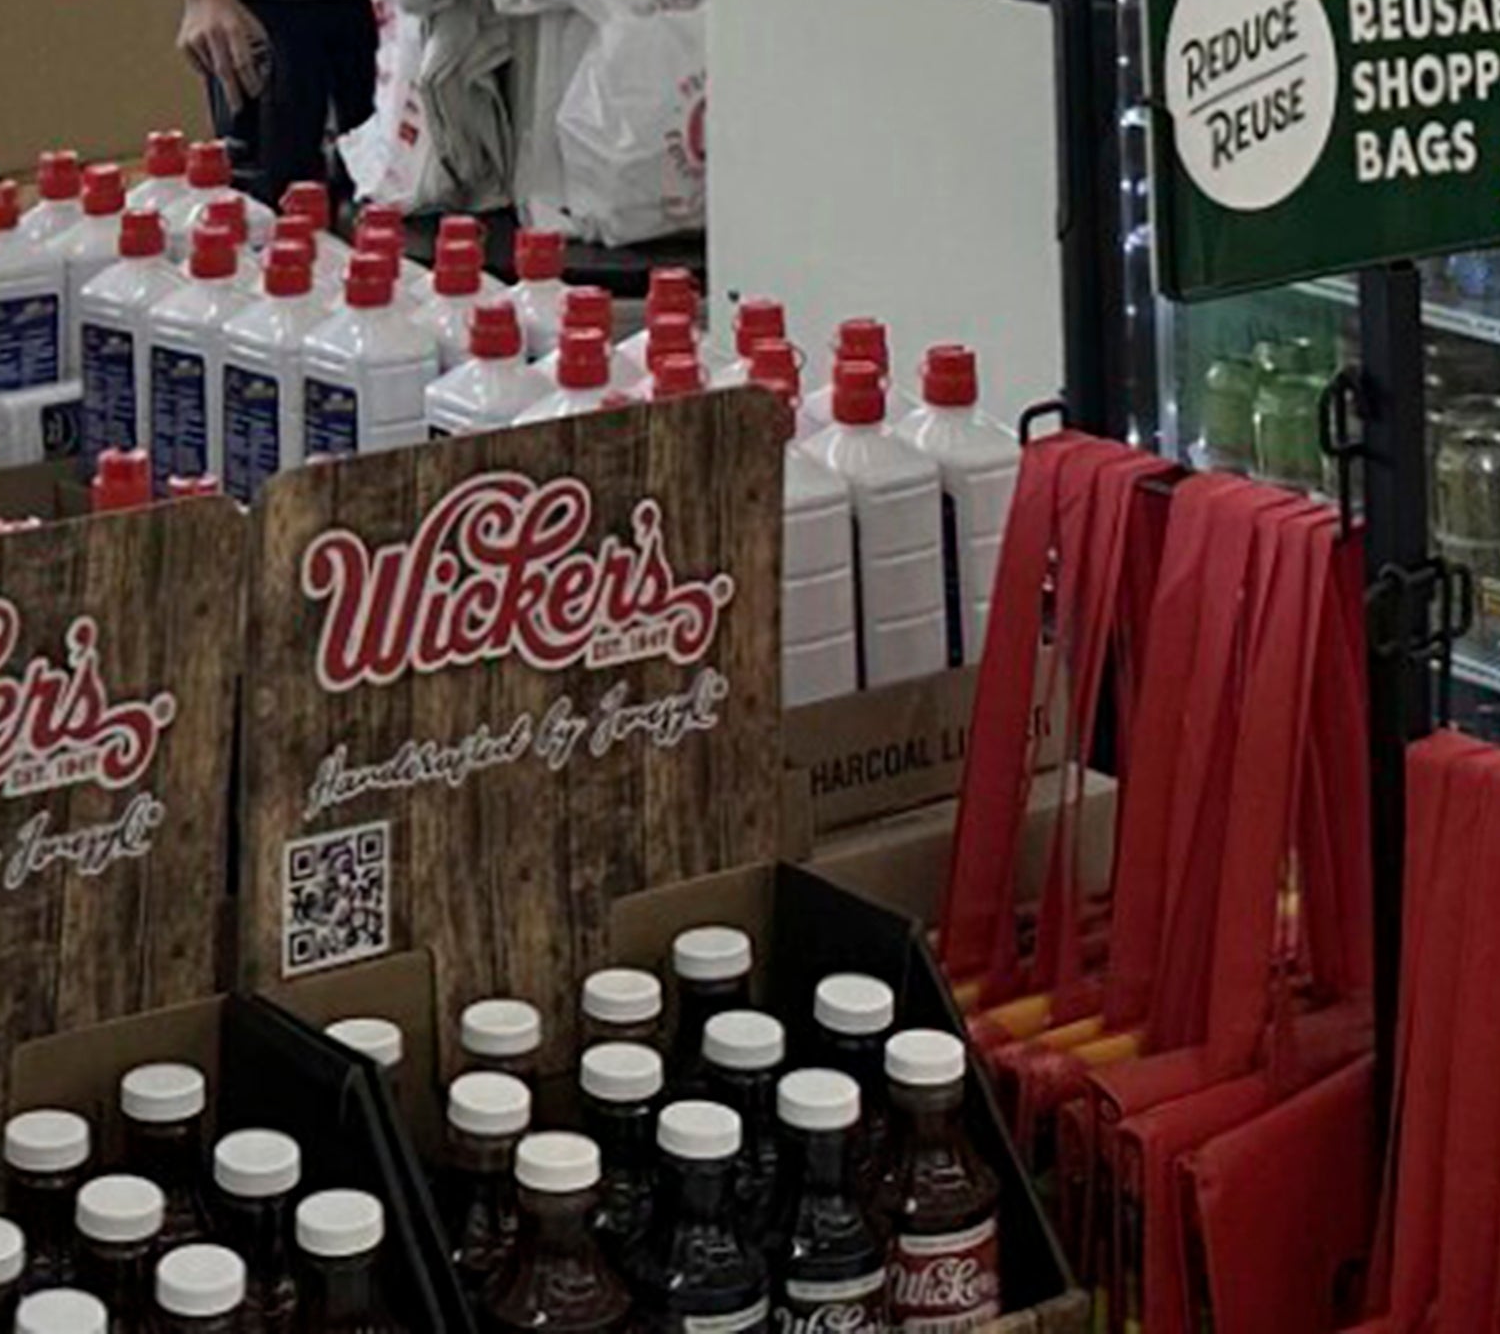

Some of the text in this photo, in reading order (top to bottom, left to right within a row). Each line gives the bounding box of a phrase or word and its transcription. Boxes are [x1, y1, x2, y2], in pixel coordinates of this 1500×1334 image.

[1205, 78, 1308, 171] REUSE
[1356, 120, 1478, 182] BAGS
[302, 471, 736, 692] Wicker's
[305, 729, 530, 820] Handcrafted
[535, 697, 586, 769] by
[808, 736, 933, 797] HARCOAL
